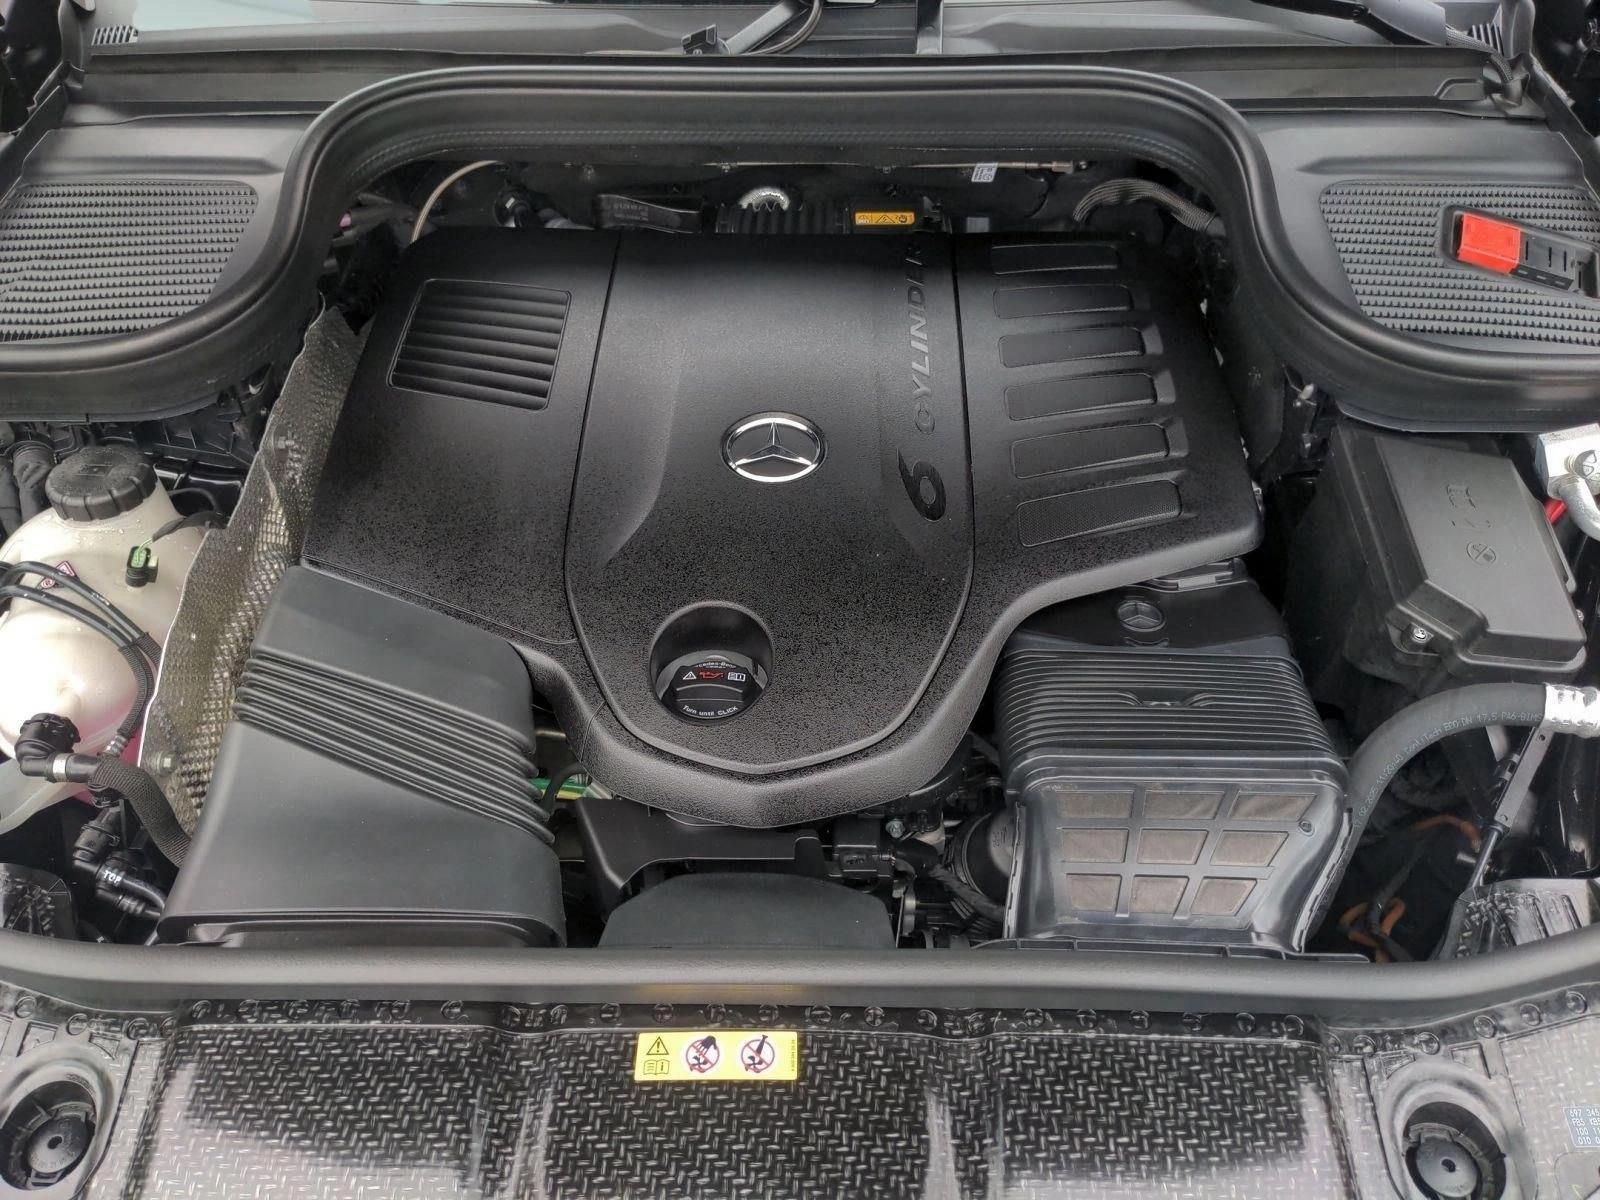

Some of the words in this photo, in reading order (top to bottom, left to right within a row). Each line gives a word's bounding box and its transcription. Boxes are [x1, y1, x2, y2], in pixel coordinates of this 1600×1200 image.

[896, 447, 947, 522] 6
[683, 705, 697, 715] Turn
[717, 705, 738, 716] CLICK
[103, 869, 122, 884] TOP
